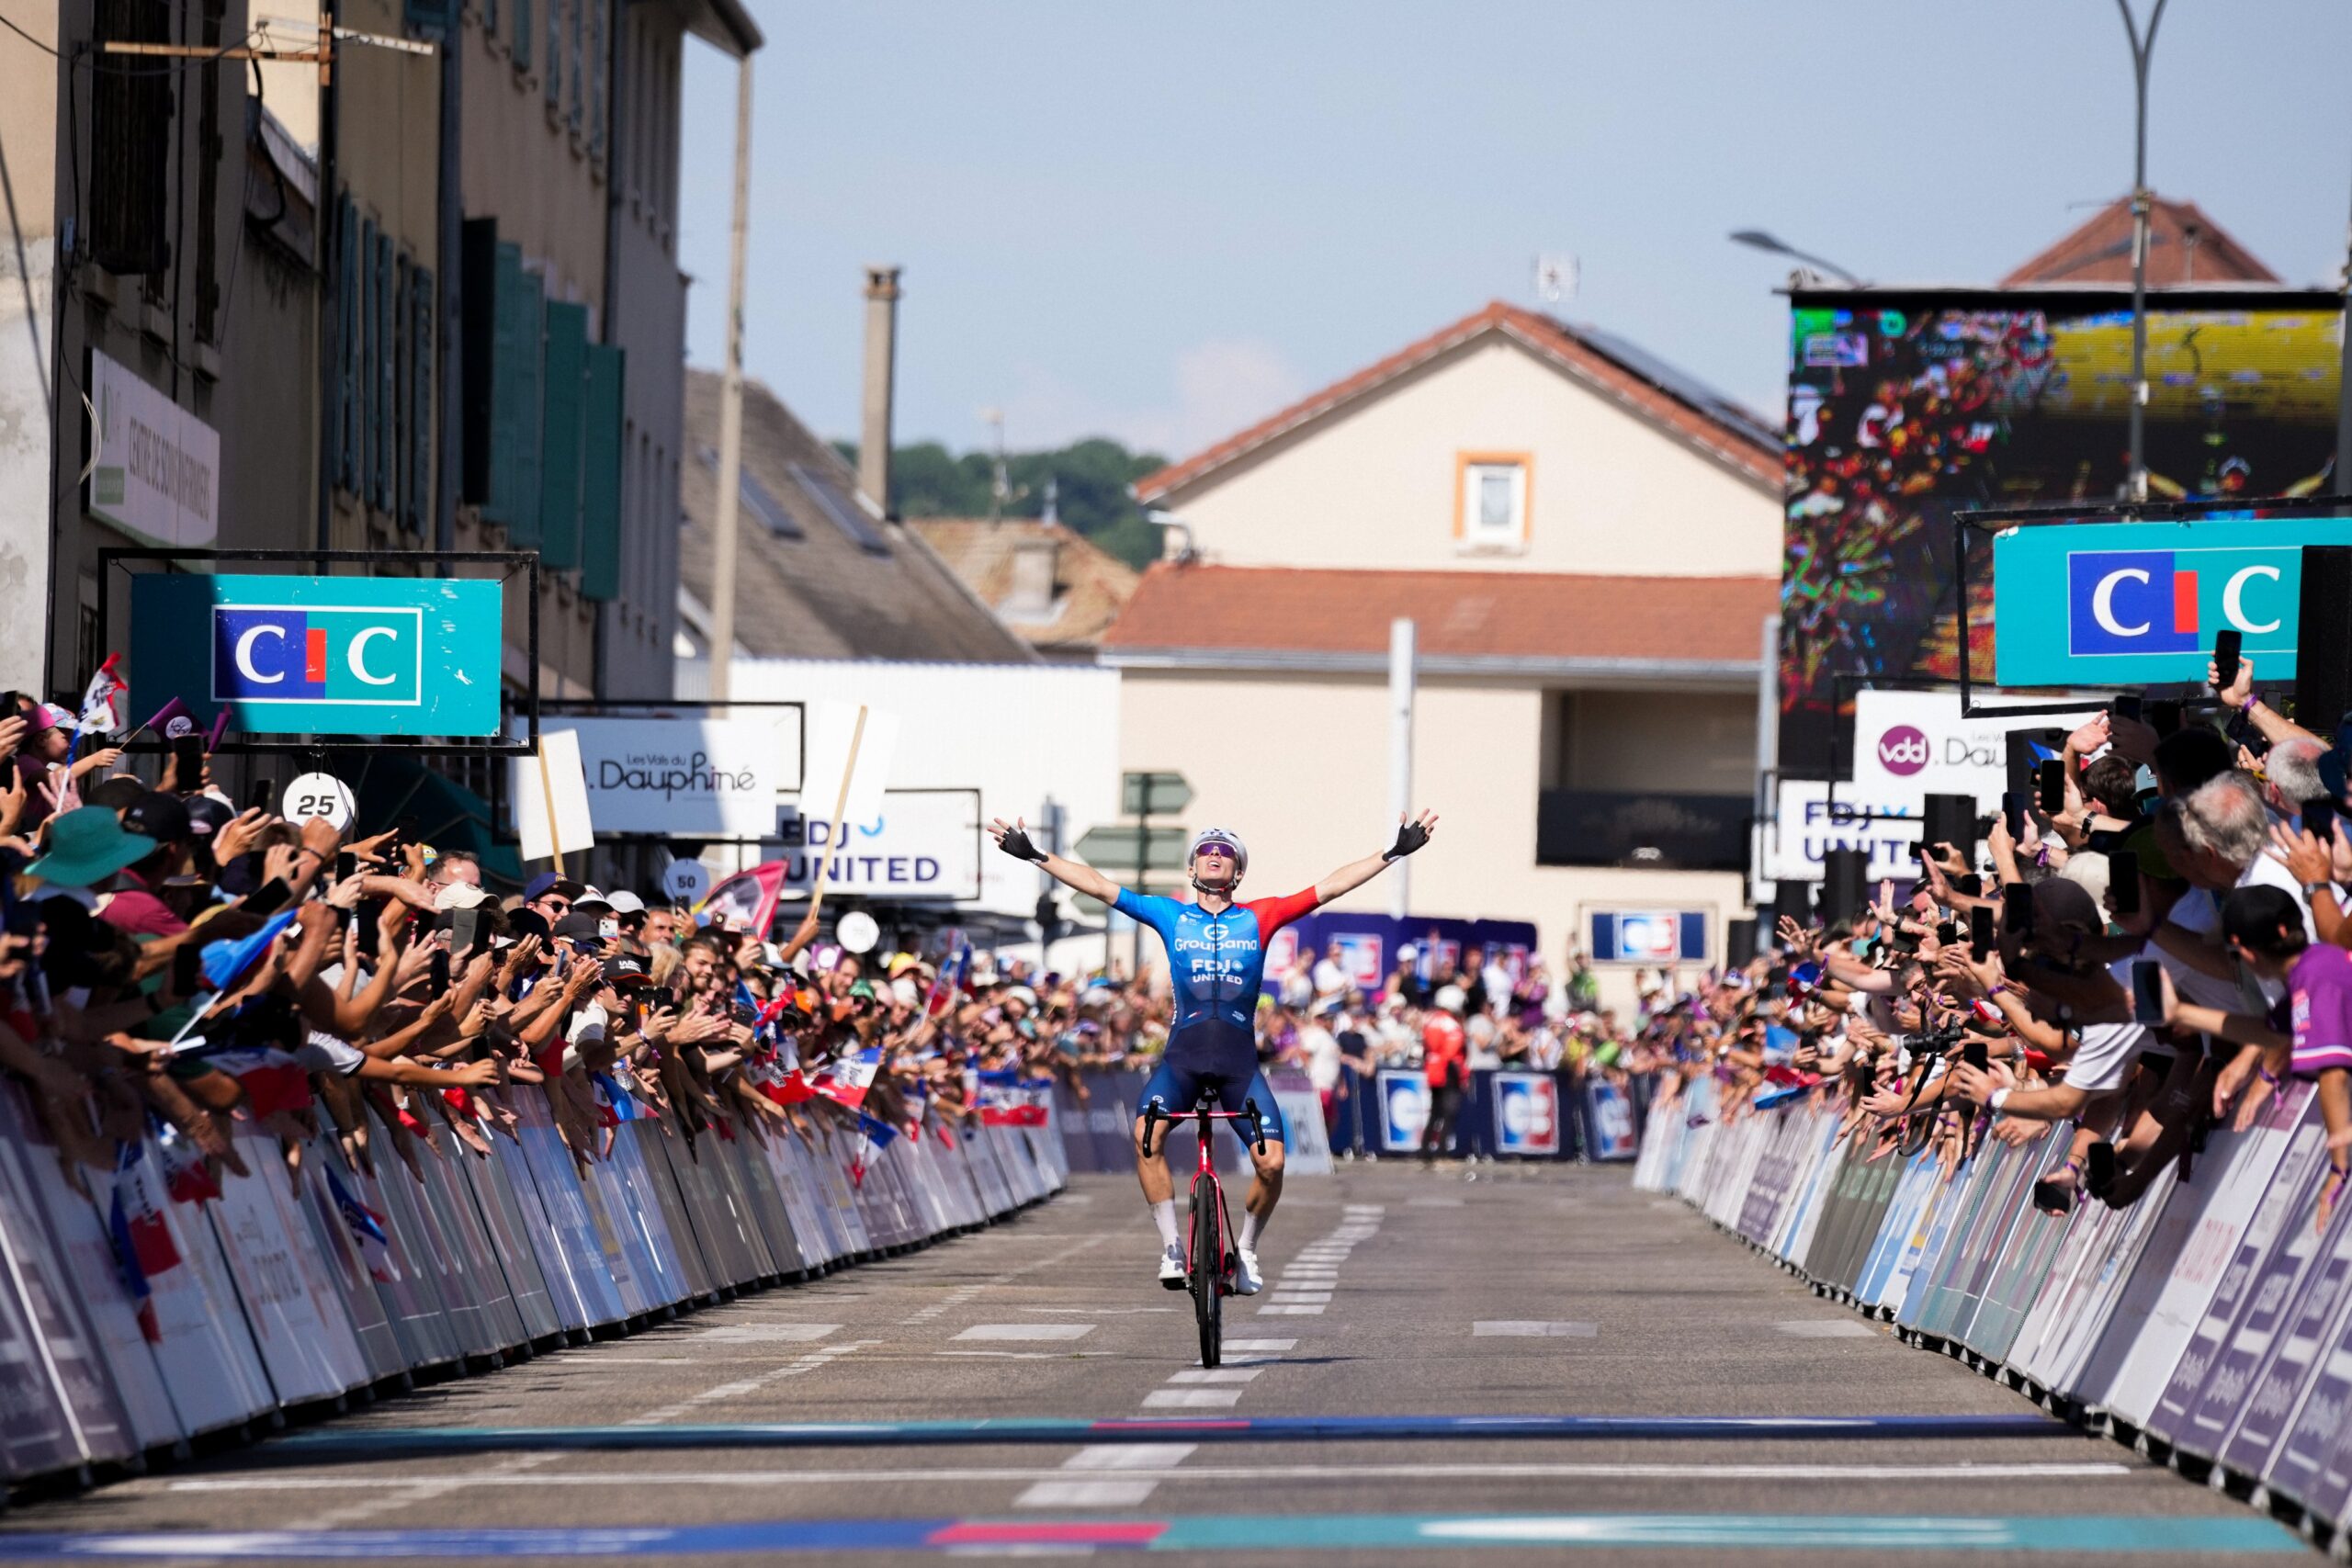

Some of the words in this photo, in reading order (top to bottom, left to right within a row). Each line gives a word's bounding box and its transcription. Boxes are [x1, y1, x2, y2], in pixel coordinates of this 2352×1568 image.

[2093, 565, 2281, 637] CIC
[235, 625, 398, 685] CIC
[627, 753, 644, 765] Les
[647, 753, 669, 765] Vals
[672, 753, 686, 765] du
[1880, 736, 1927, 764] vdd
[600, 751, 756, 803] Dauphiné
[297, 795, 335, 816] 25
[1805, 802, 1872, 831] FDJ
[786, 857, 940, 882] UNITED
[677, 875, 696, 889] 50
[1175, 938, 1258, 953] Groupama
[1191, 959, 1231, 974] FDJ
[1193, 973, 1243, 986] UNITED
